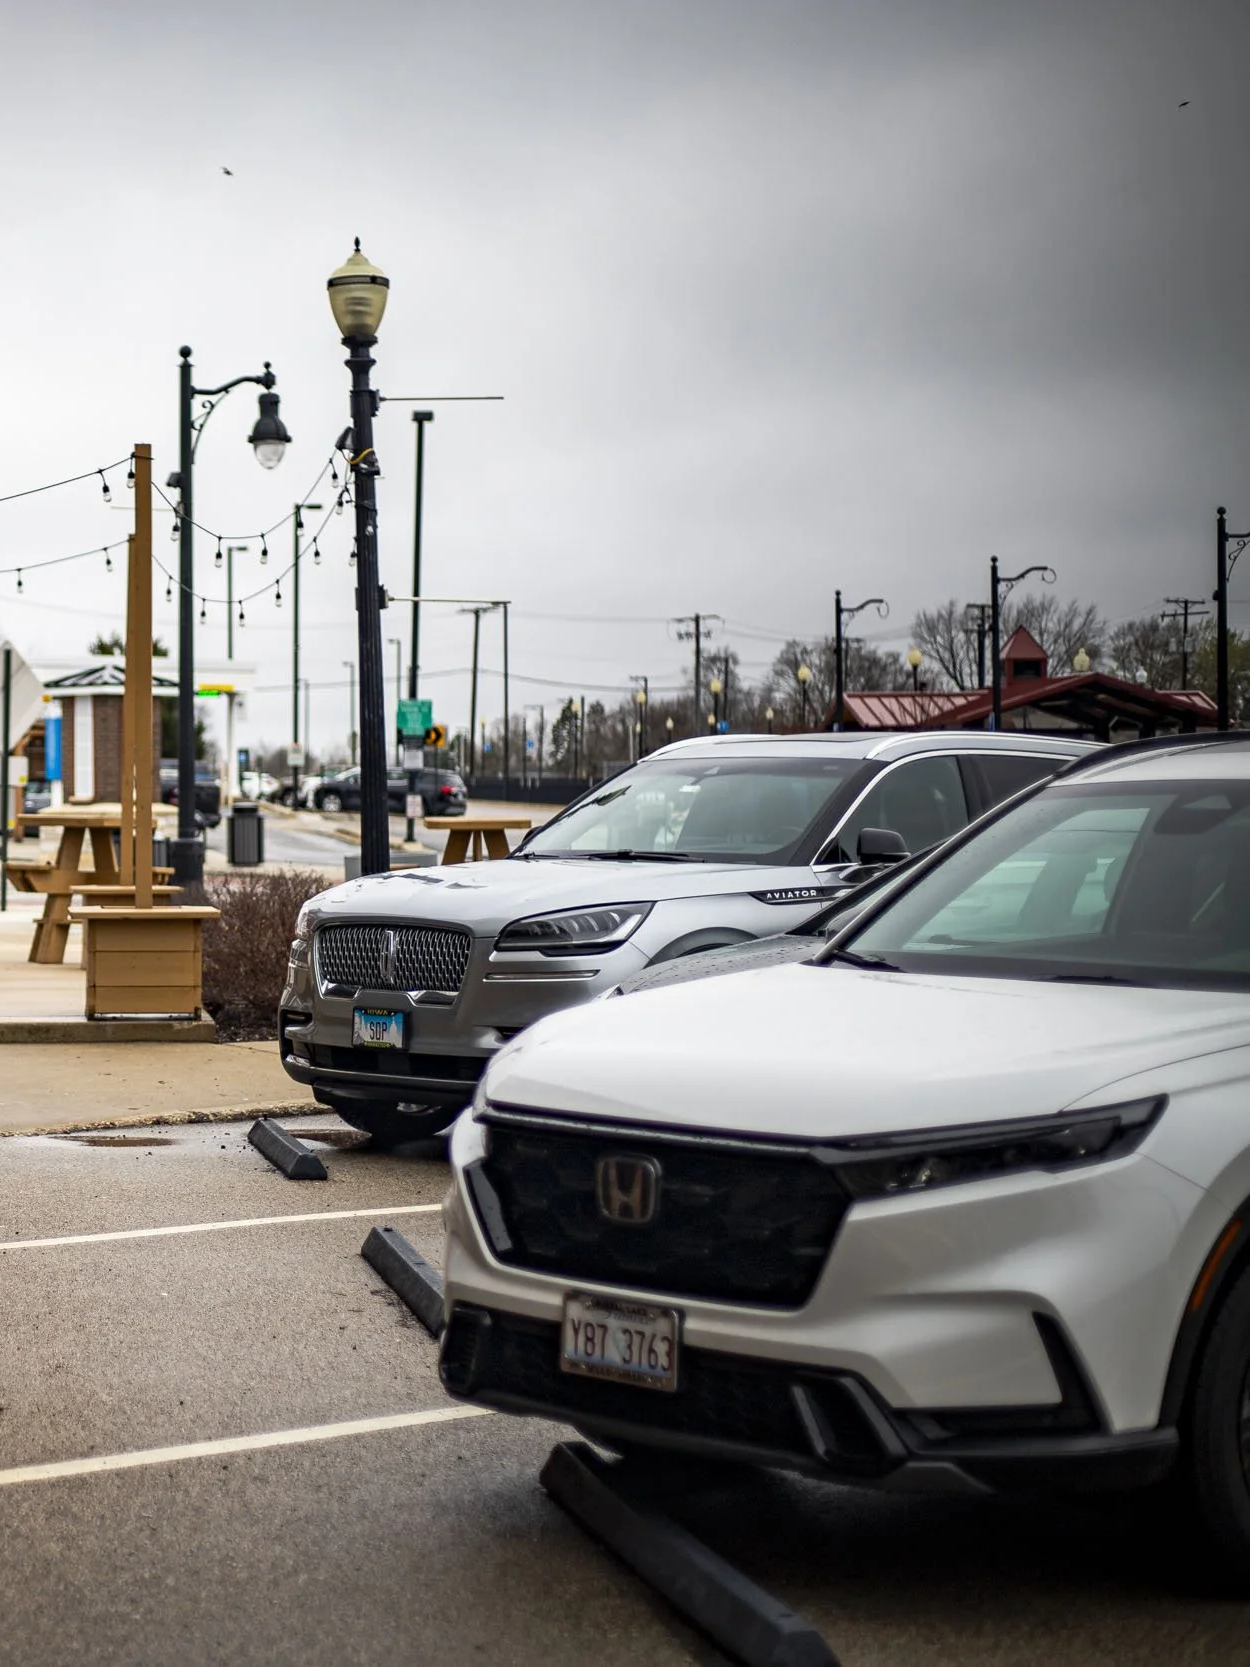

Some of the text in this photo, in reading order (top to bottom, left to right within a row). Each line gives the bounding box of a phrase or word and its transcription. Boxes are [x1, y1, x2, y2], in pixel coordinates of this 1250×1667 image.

[766, 889, 817, 900] AVIATOR
[571, 1318, 671, 1372] Y87 3763
